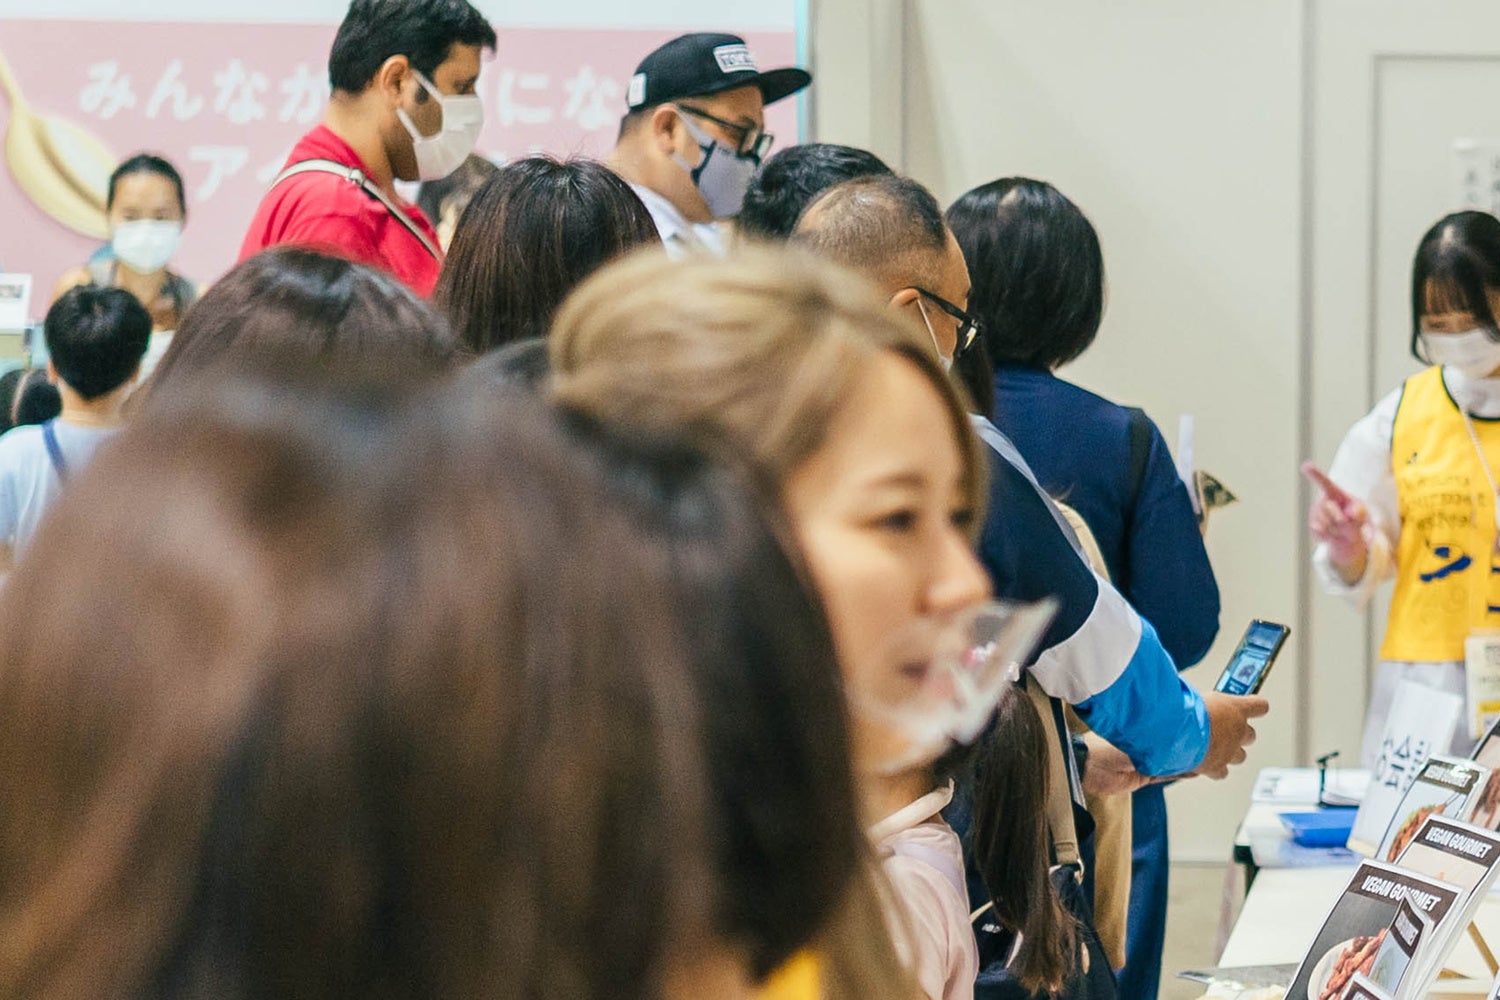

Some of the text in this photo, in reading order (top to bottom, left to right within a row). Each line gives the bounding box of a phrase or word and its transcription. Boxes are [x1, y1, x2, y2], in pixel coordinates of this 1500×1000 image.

[1425, 826, 1493, 859] VEGAN GOURMET
[1361, 874, 1392, 898] VEGAN
